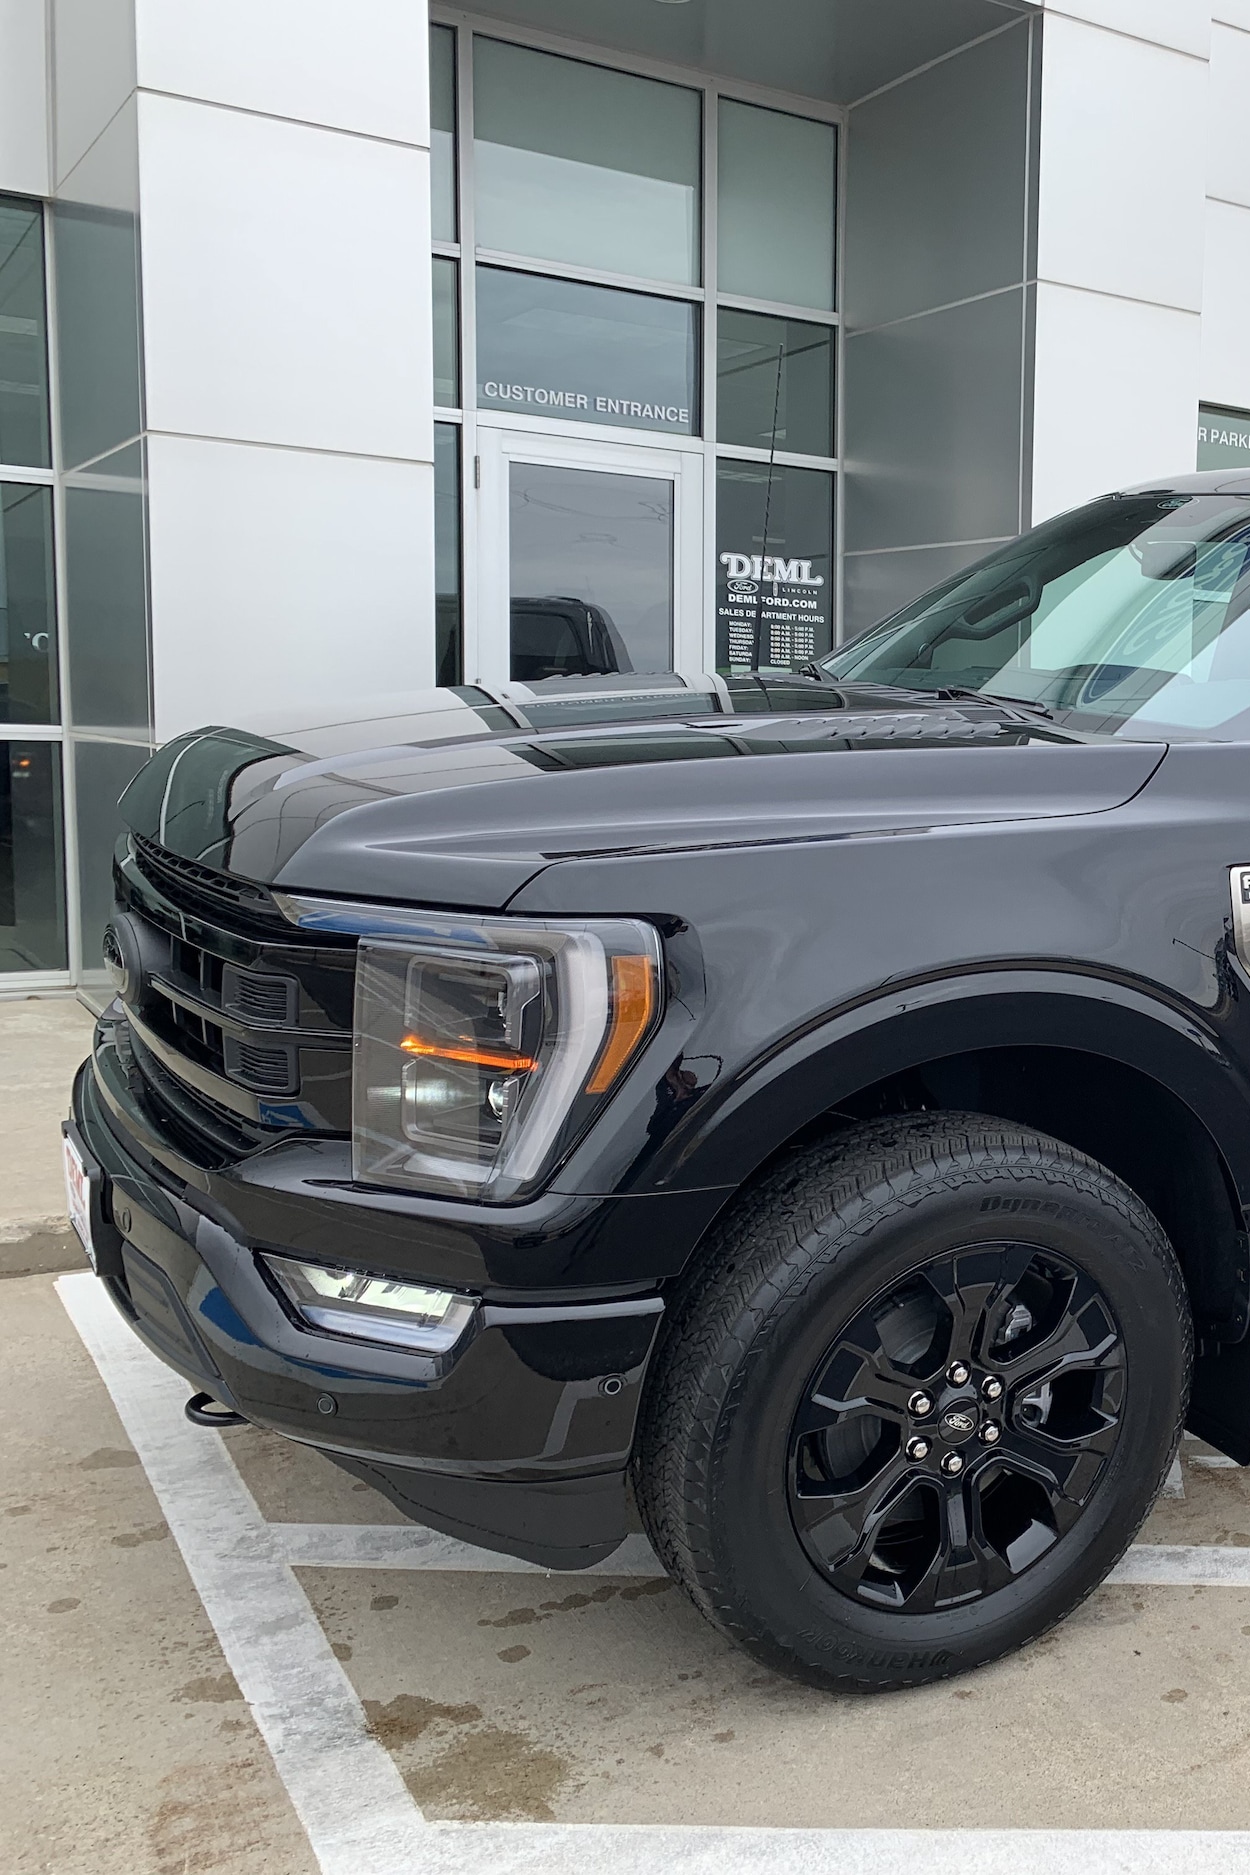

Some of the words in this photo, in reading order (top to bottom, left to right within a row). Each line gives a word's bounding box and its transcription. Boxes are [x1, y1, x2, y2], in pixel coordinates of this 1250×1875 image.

[484, 381, 588, 409] CUSTOMER
[596, 396, 689, 423] ENTRANCE
[719, 551, 825, 587] DEML
[782, 587, 818, 595] LINCOLN
[718, 607, 744, 617] SALES
[745, 609, 797, 620] DEARTMENT
[798, 614, 825, 624] HOURS
